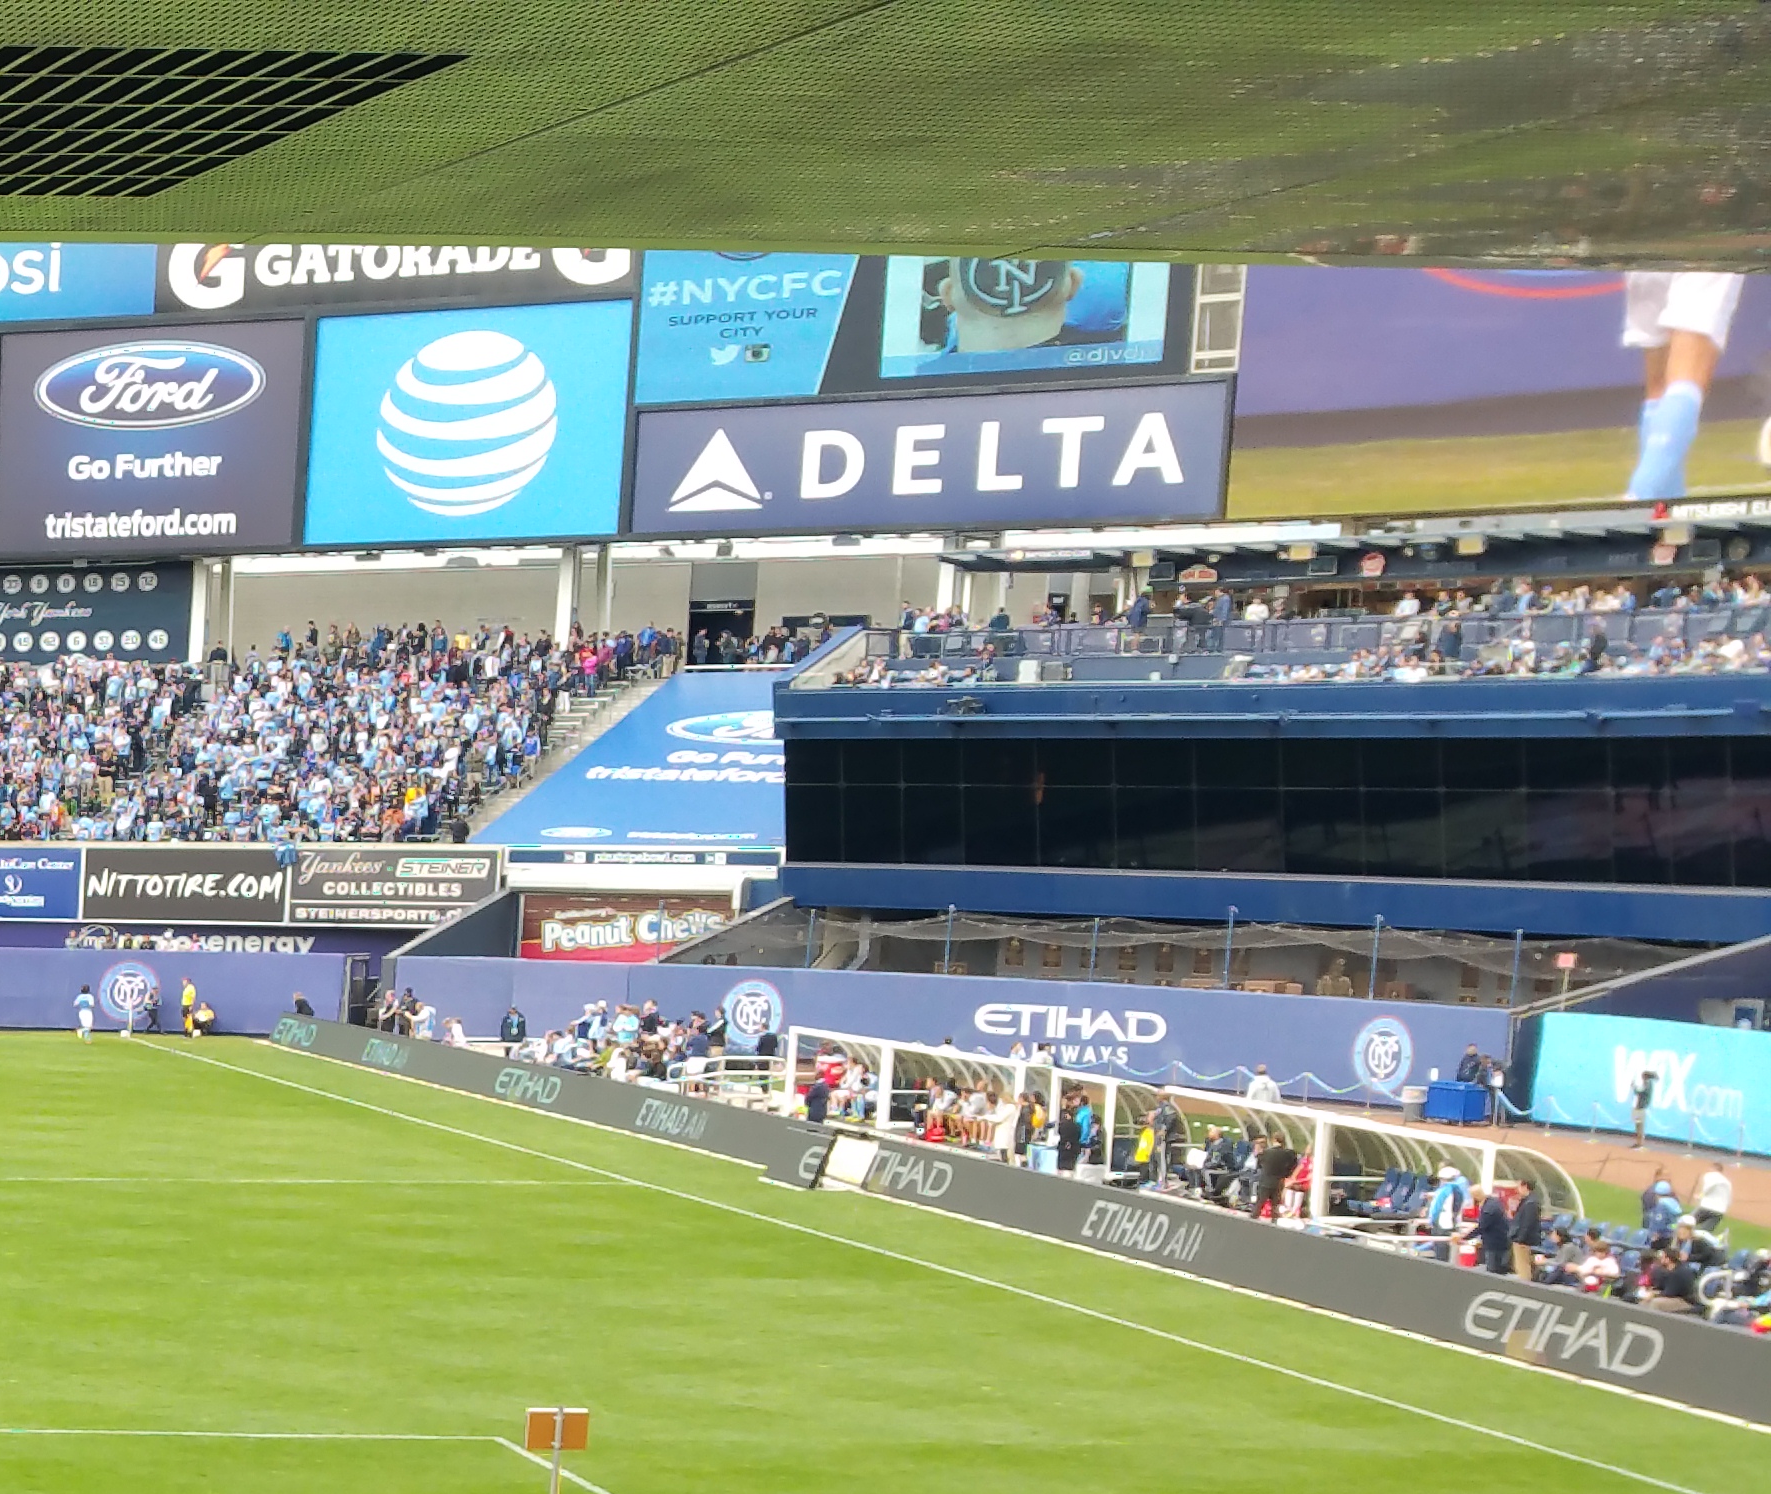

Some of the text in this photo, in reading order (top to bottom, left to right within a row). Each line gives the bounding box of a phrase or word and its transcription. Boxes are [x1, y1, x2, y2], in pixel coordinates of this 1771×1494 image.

[648, 269, 843, 308] #NYCFC
[668, 307, 818, 328] SUPPORT YOUR
[719, 324, 763, 339] CITY
[80, 353, 215, 415] Ford
[68, 450, 222, 482] Go Further
[800, 412, 1184, 502] DELTA
[45, 506, 238, 541] tristateford.com
[88, 868, 284, 903] NITTOTIRE.COM
[322, 882, 462, 898] COLLECTIBLES
[543, 915, 634, 950] Peanut
[273, 1019, 318, 1047] ETIHAD
[974, 1003, 1167, 1044] ETIHAD
[494, 1067, 562, 1104] ETIHAD
[635, 1098, 688, 1134] ETIHAD
[1082, 1200, 1169, 1252] ETIHAD
[1464, 1290, 1664, 1377] ETIHAD
